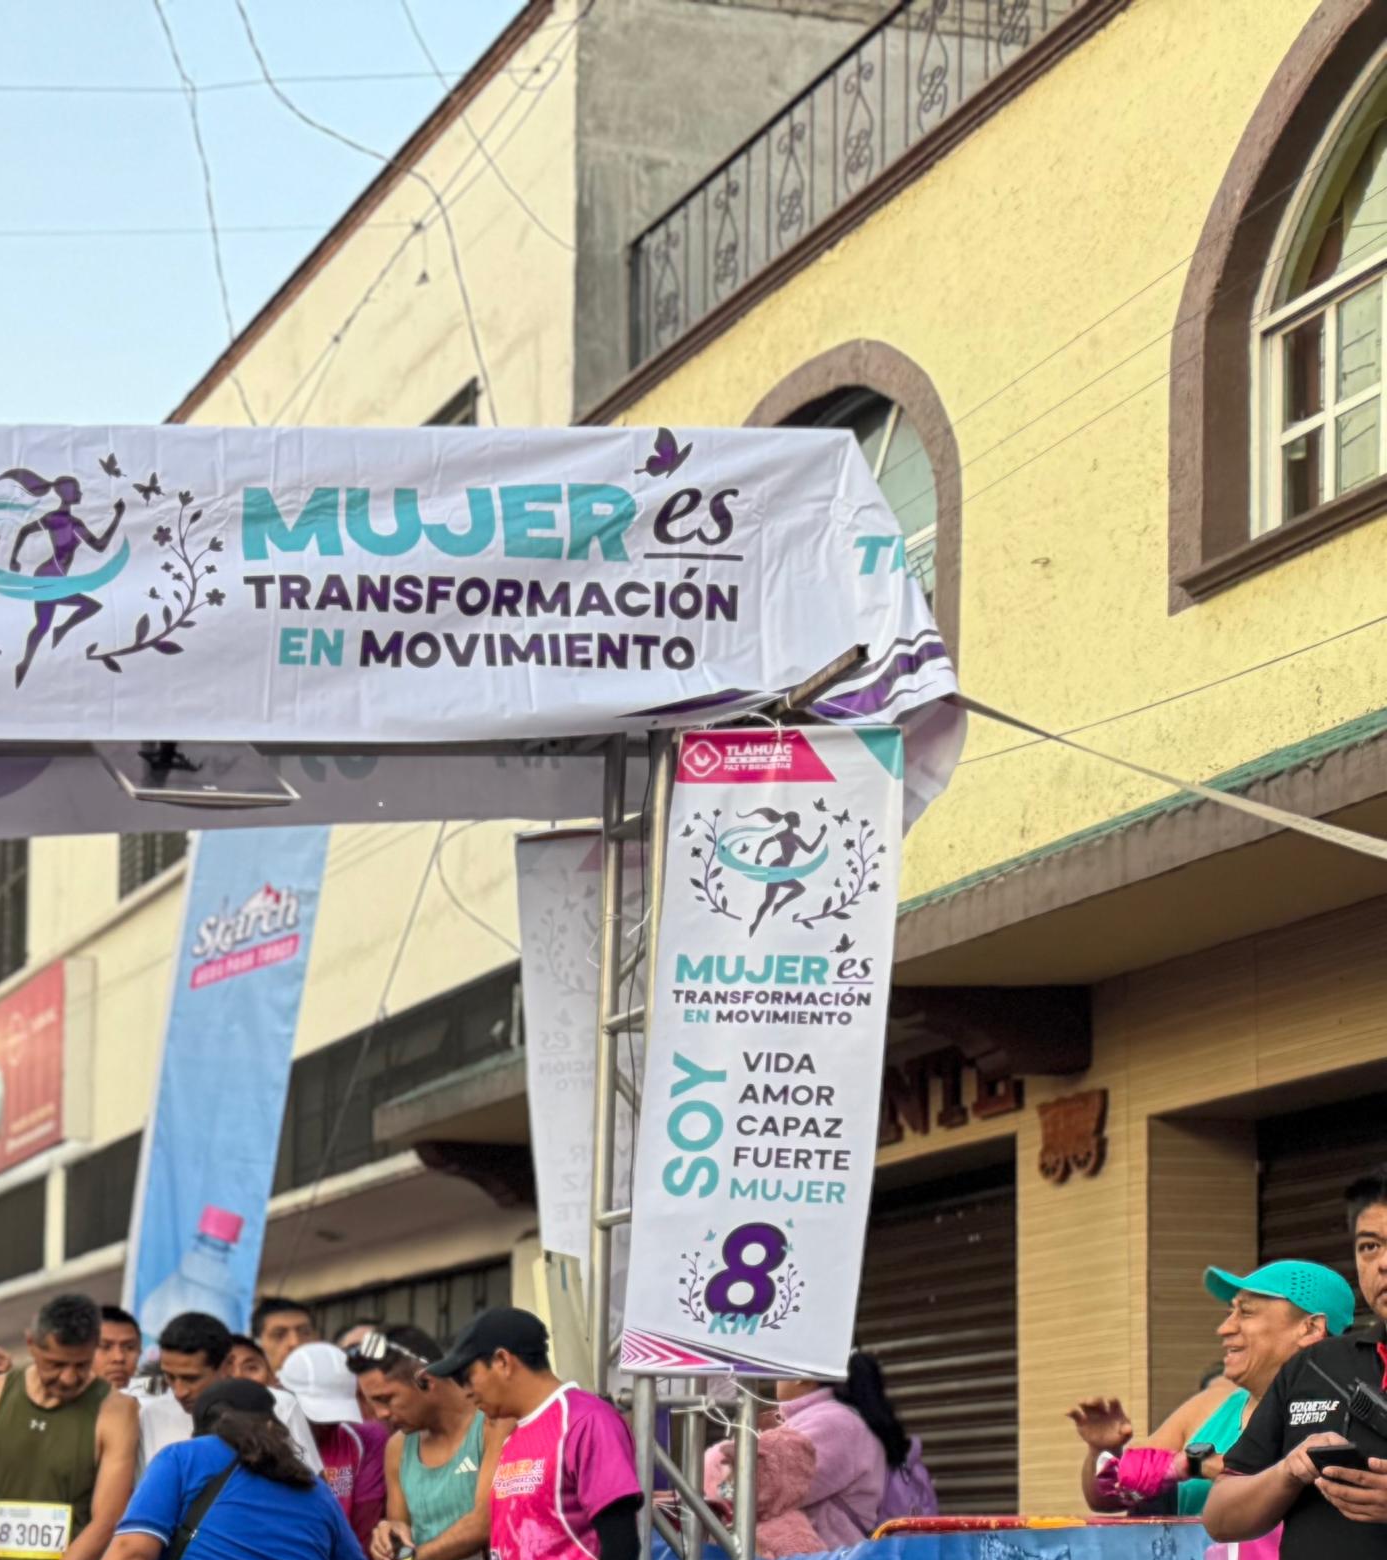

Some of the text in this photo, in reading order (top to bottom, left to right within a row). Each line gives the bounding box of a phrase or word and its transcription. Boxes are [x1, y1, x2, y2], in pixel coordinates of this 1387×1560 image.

[241, 481, 742, 563] MUJER es
[243, 569, 740, 623] TRANSFORMACIÓN
[278, 627, 696, 672] EN MOVIMIENTO
[725, 739, 793, 756] TLÁHUAC
[675, 953, 874, 985] MUJER es
[672, 986, 872, 1008] TRANSFORMACIÓN
[683, 1008, 853, 1027] EN MOVIMIENTO
[742, 1051, 817, 1075] VIDA
[738, 1083, 835, 1107] AMOR
[662, 1052, 727, 1200] SOY
[736, 1115, 844, 1139] CAPAZ
[733, 1145, 852, 1172] FUERTE
[729, 1176, 847, 1204] MUJER
[704, 1221, 788, 1319] 8
[707, 1312, 762, 1337] KM
[15, 1523, 65, 1548] 3067
